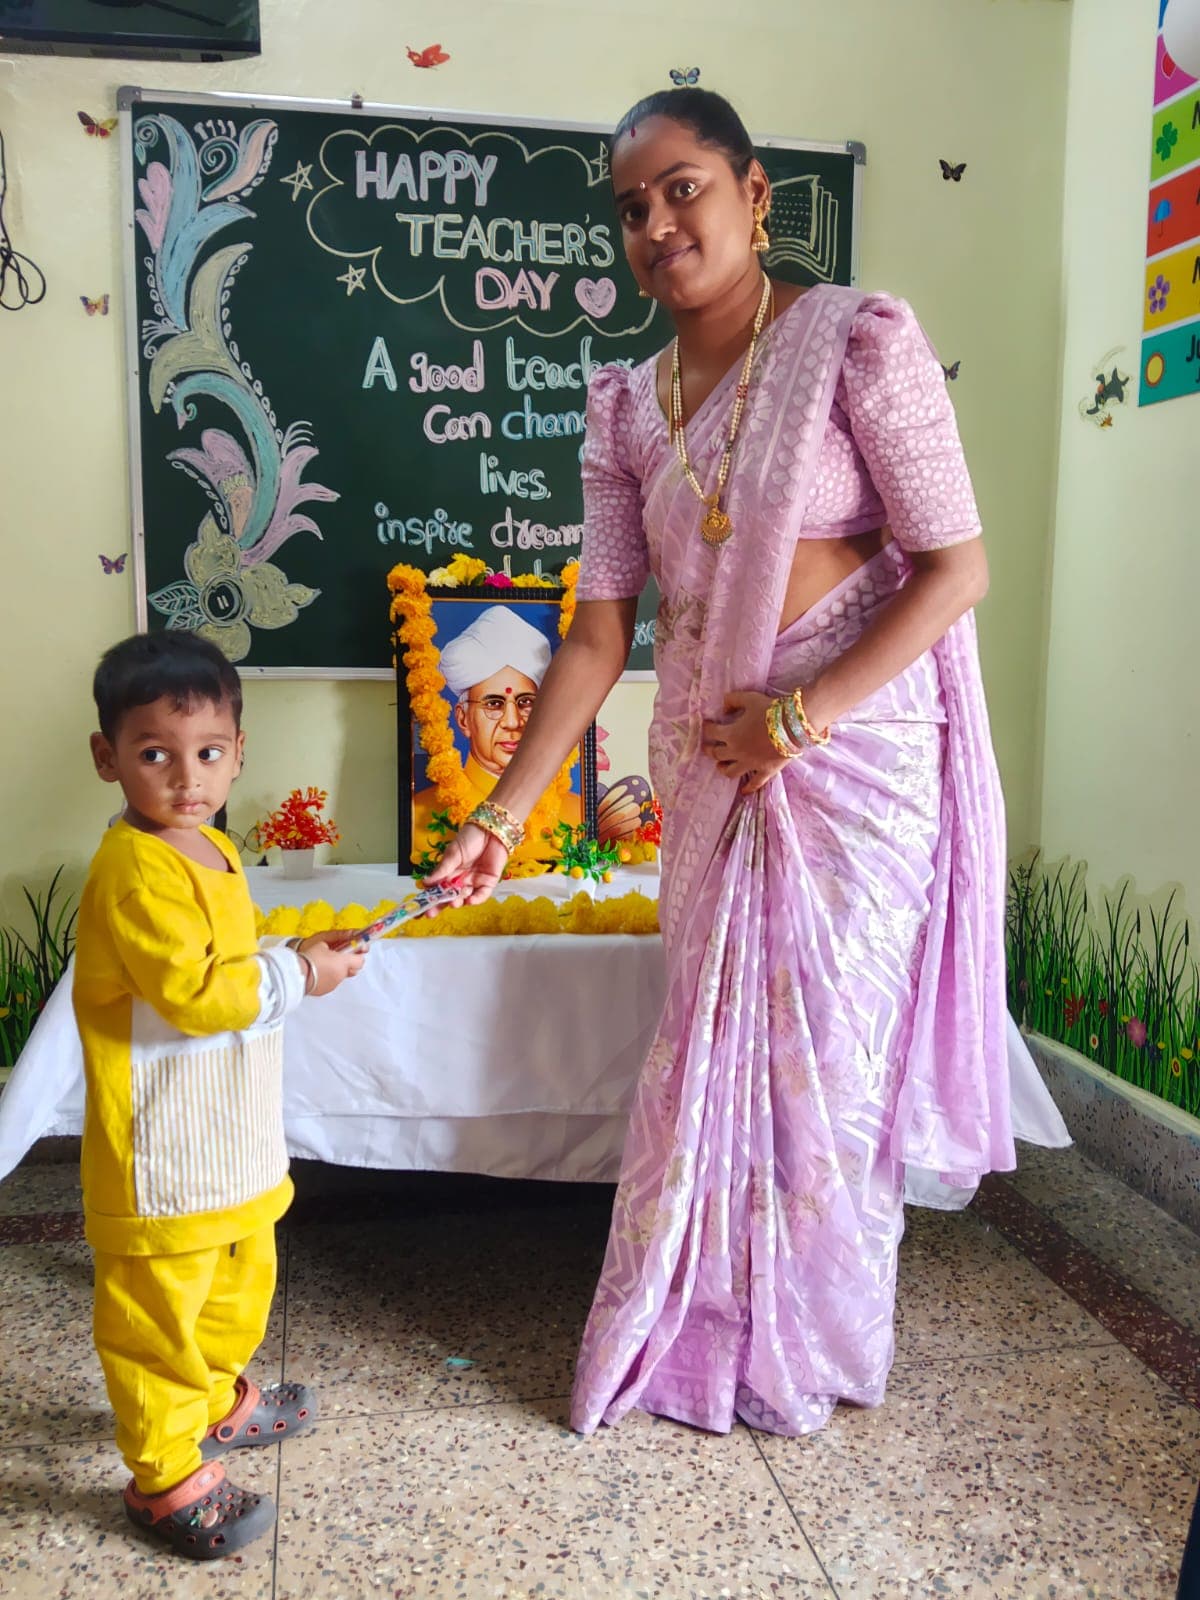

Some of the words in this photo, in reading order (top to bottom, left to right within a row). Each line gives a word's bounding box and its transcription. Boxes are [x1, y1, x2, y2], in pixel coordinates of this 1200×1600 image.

[355, 150, 498, 206] HAPPY
[396, 213, 614, 267] TEACHER'S
[475, 267, 560, 310] DAY
[362, 336, 397, 391] A
[409, 339, 485, 392] good
[374, 502, 474, 554] inspire
